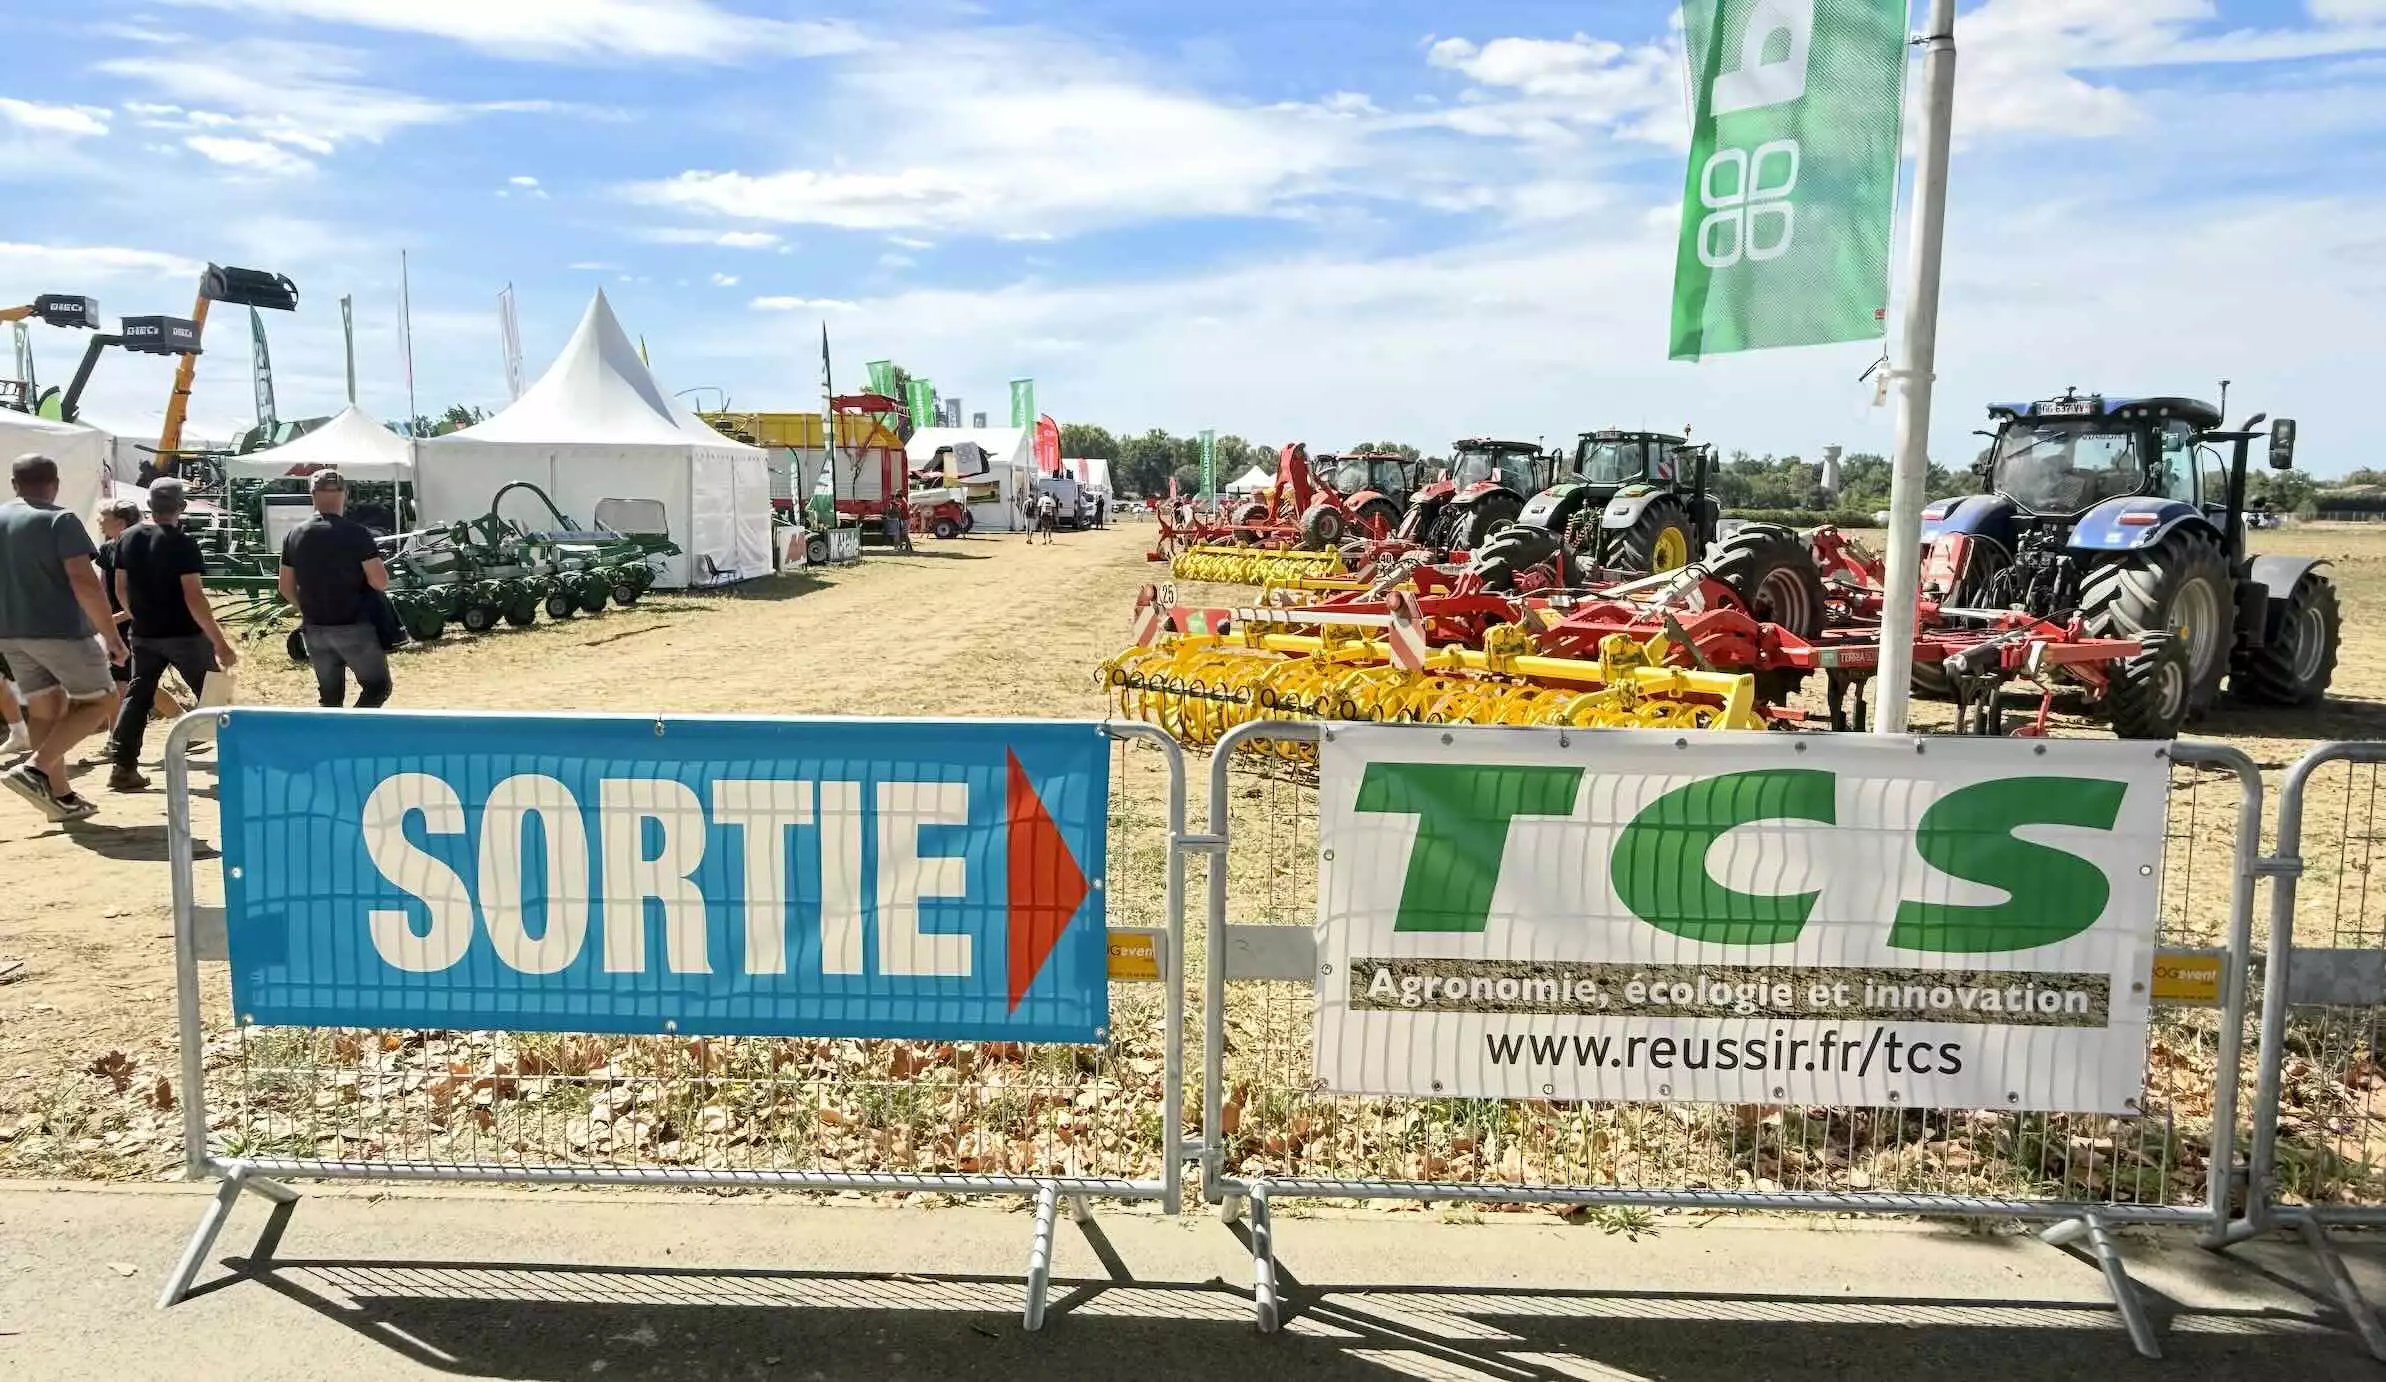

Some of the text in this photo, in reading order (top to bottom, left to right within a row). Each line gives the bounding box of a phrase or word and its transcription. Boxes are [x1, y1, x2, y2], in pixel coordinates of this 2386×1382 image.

[1162, 585, 1174, 604] 25
[361, 772, 972, 978] SORTIE
[1354, 762, 2128, 953] TCS
[1367, 967, 2088, 1016] Agronomie, écologie et innovation
[1486, 1027, 1962, 1077] www.reussir.fr/tcs
